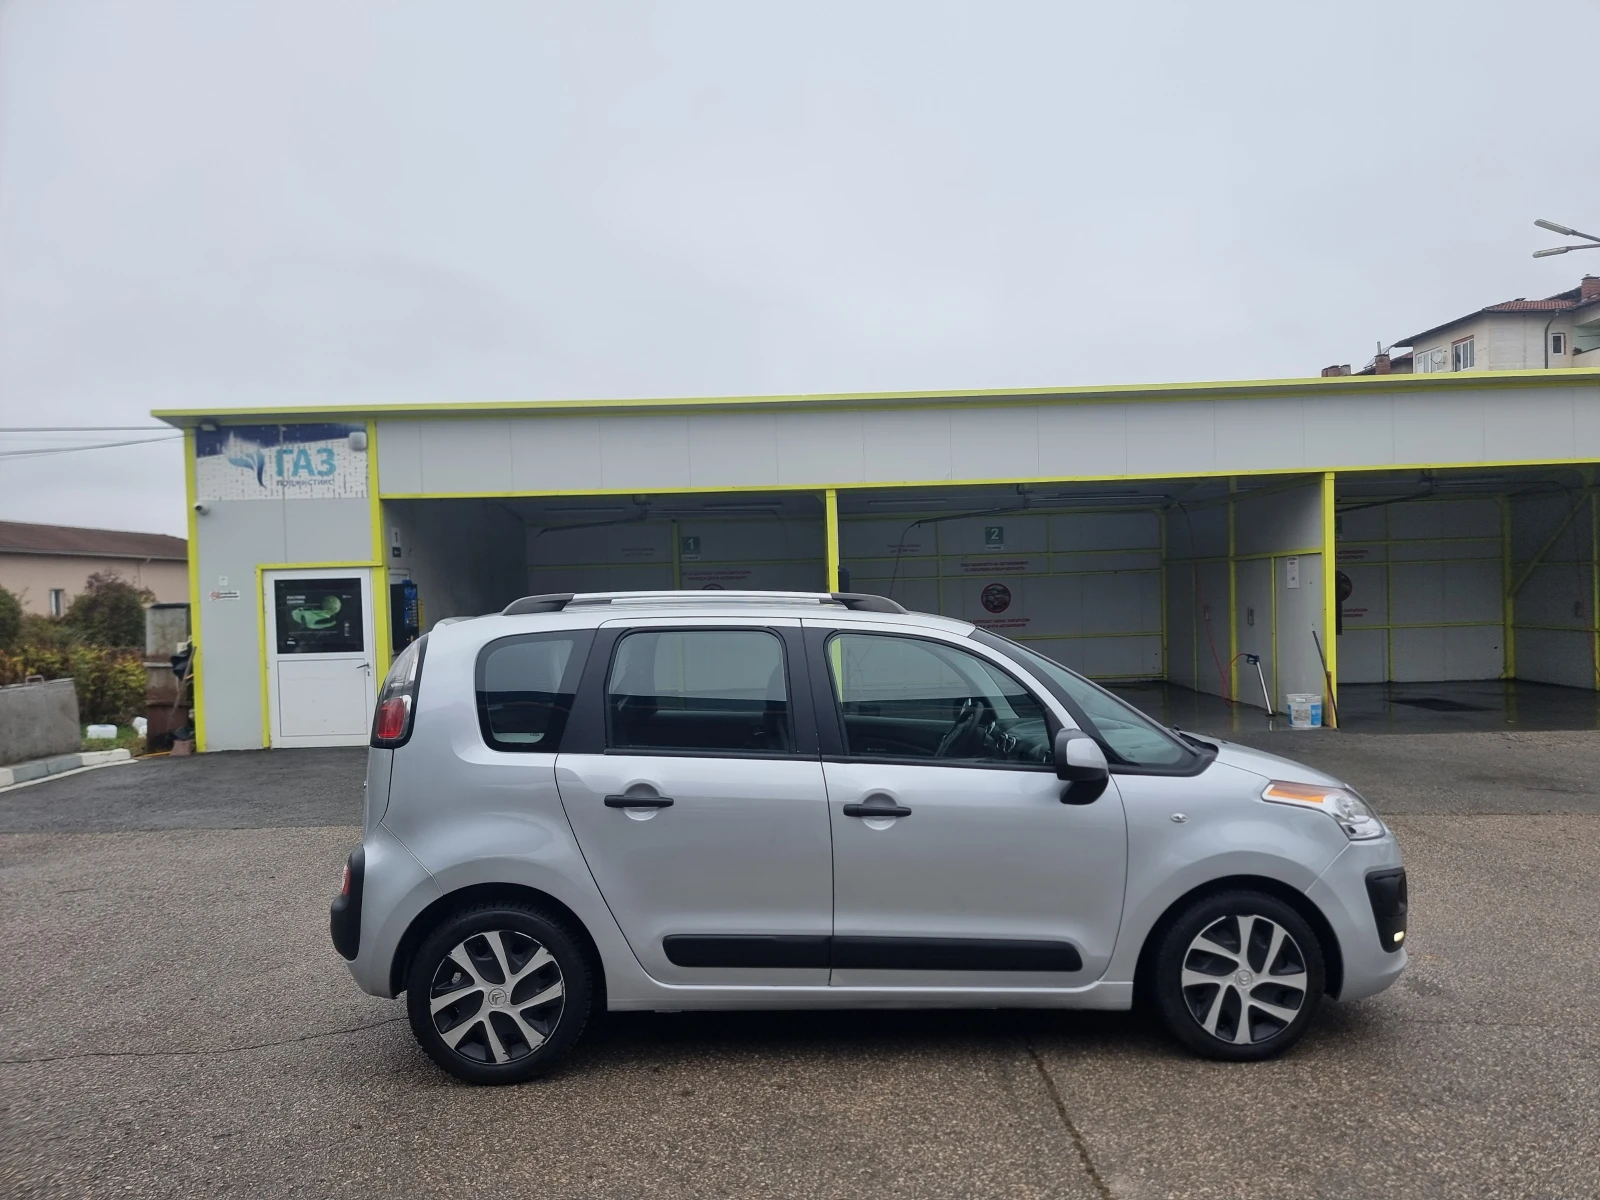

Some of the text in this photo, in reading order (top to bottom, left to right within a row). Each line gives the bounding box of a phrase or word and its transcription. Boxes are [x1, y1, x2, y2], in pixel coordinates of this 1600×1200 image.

[276, 447, 337, 477] ГАЗ
[990, 528, 1000, 540] 2
[687, 538, 694, 550] 1
